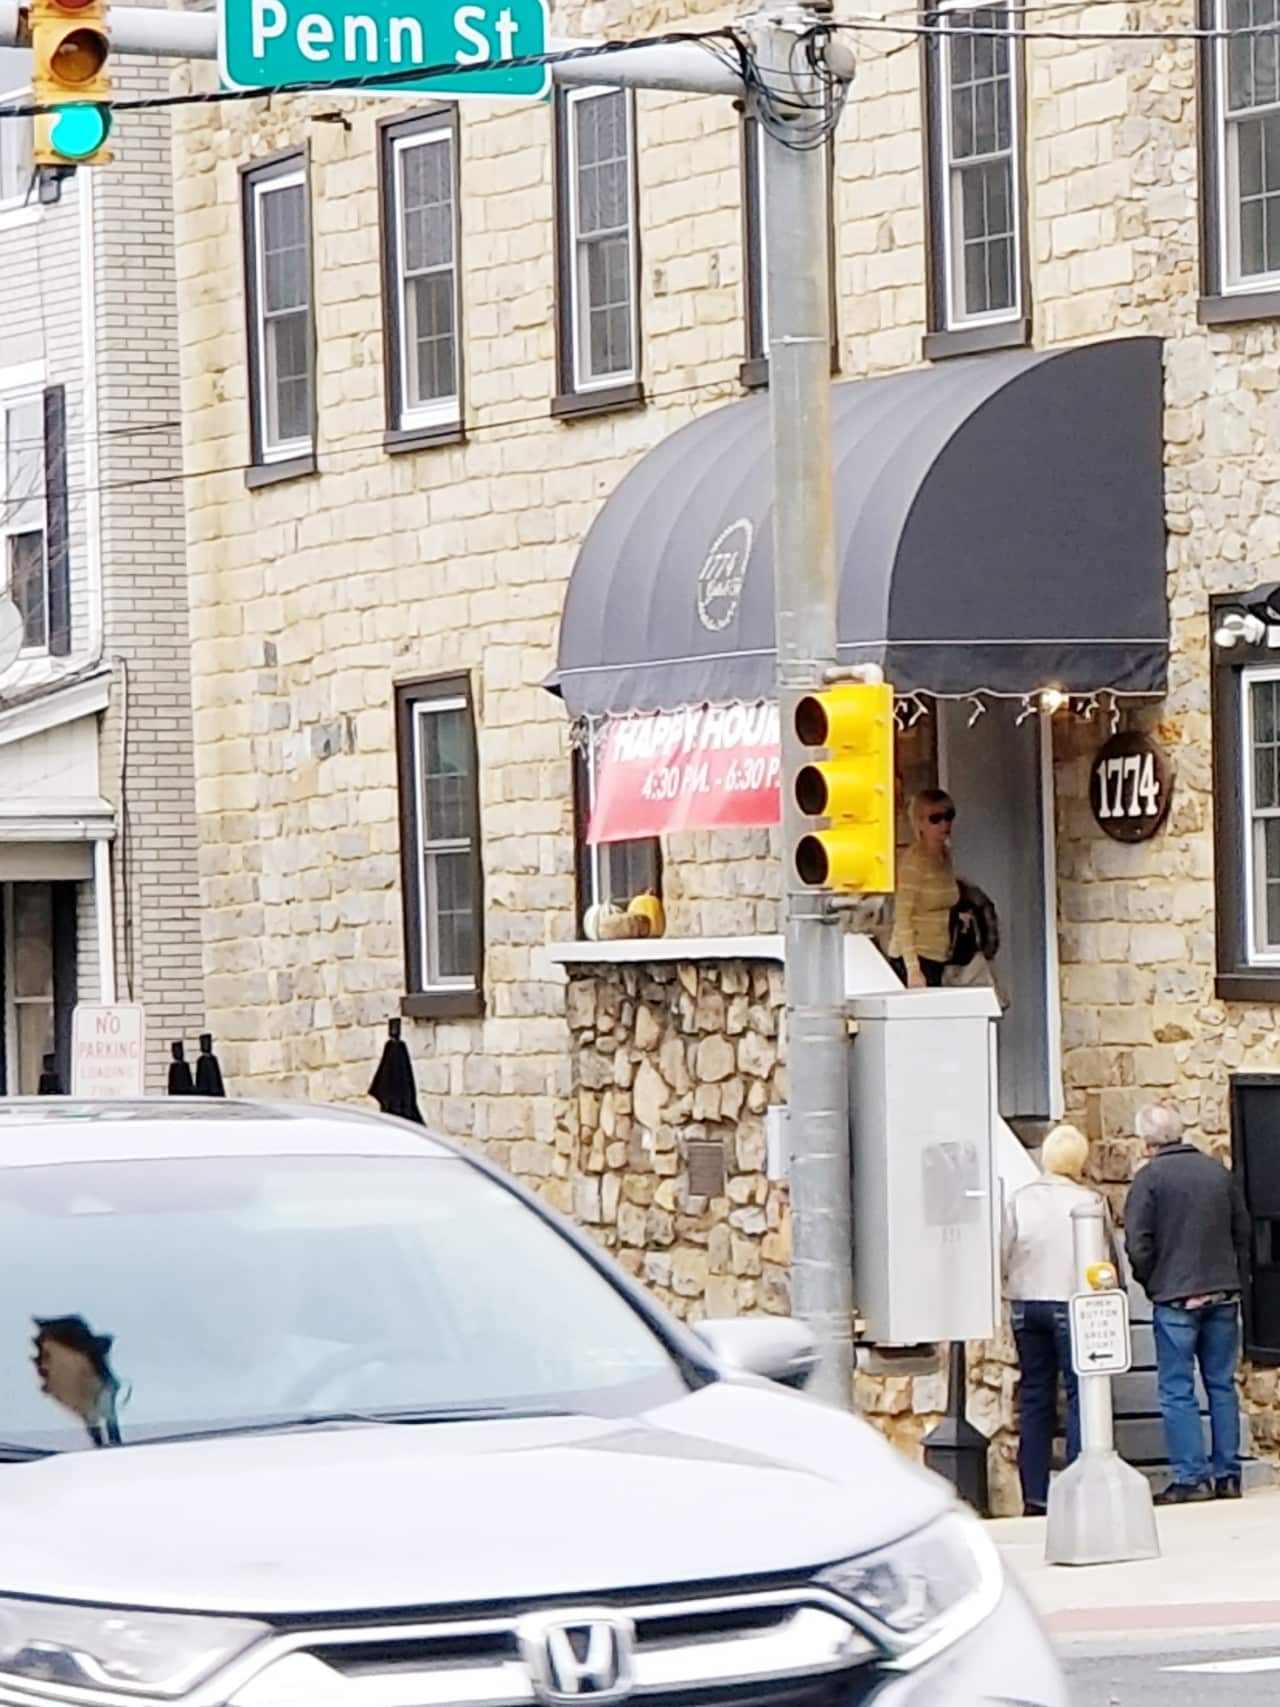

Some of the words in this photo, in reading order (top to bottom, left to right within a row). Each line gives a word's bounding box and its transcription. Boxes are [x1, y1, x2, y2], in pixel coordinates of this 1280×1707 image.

[252, 1, 424, 63] Penn
[453, 5, 520, 66] St
[698, 551, 738, 579] 1774
[612, 713, 703, 761] HAPPY
[641, 764, 680, 800] 4:30
[725, 758, 765, 791] 6:30
[1096, 752, 1160, 818] 1774
[96, 1015, 121, 1034] NO
[79, 1040, 137, 1059] PARKING
